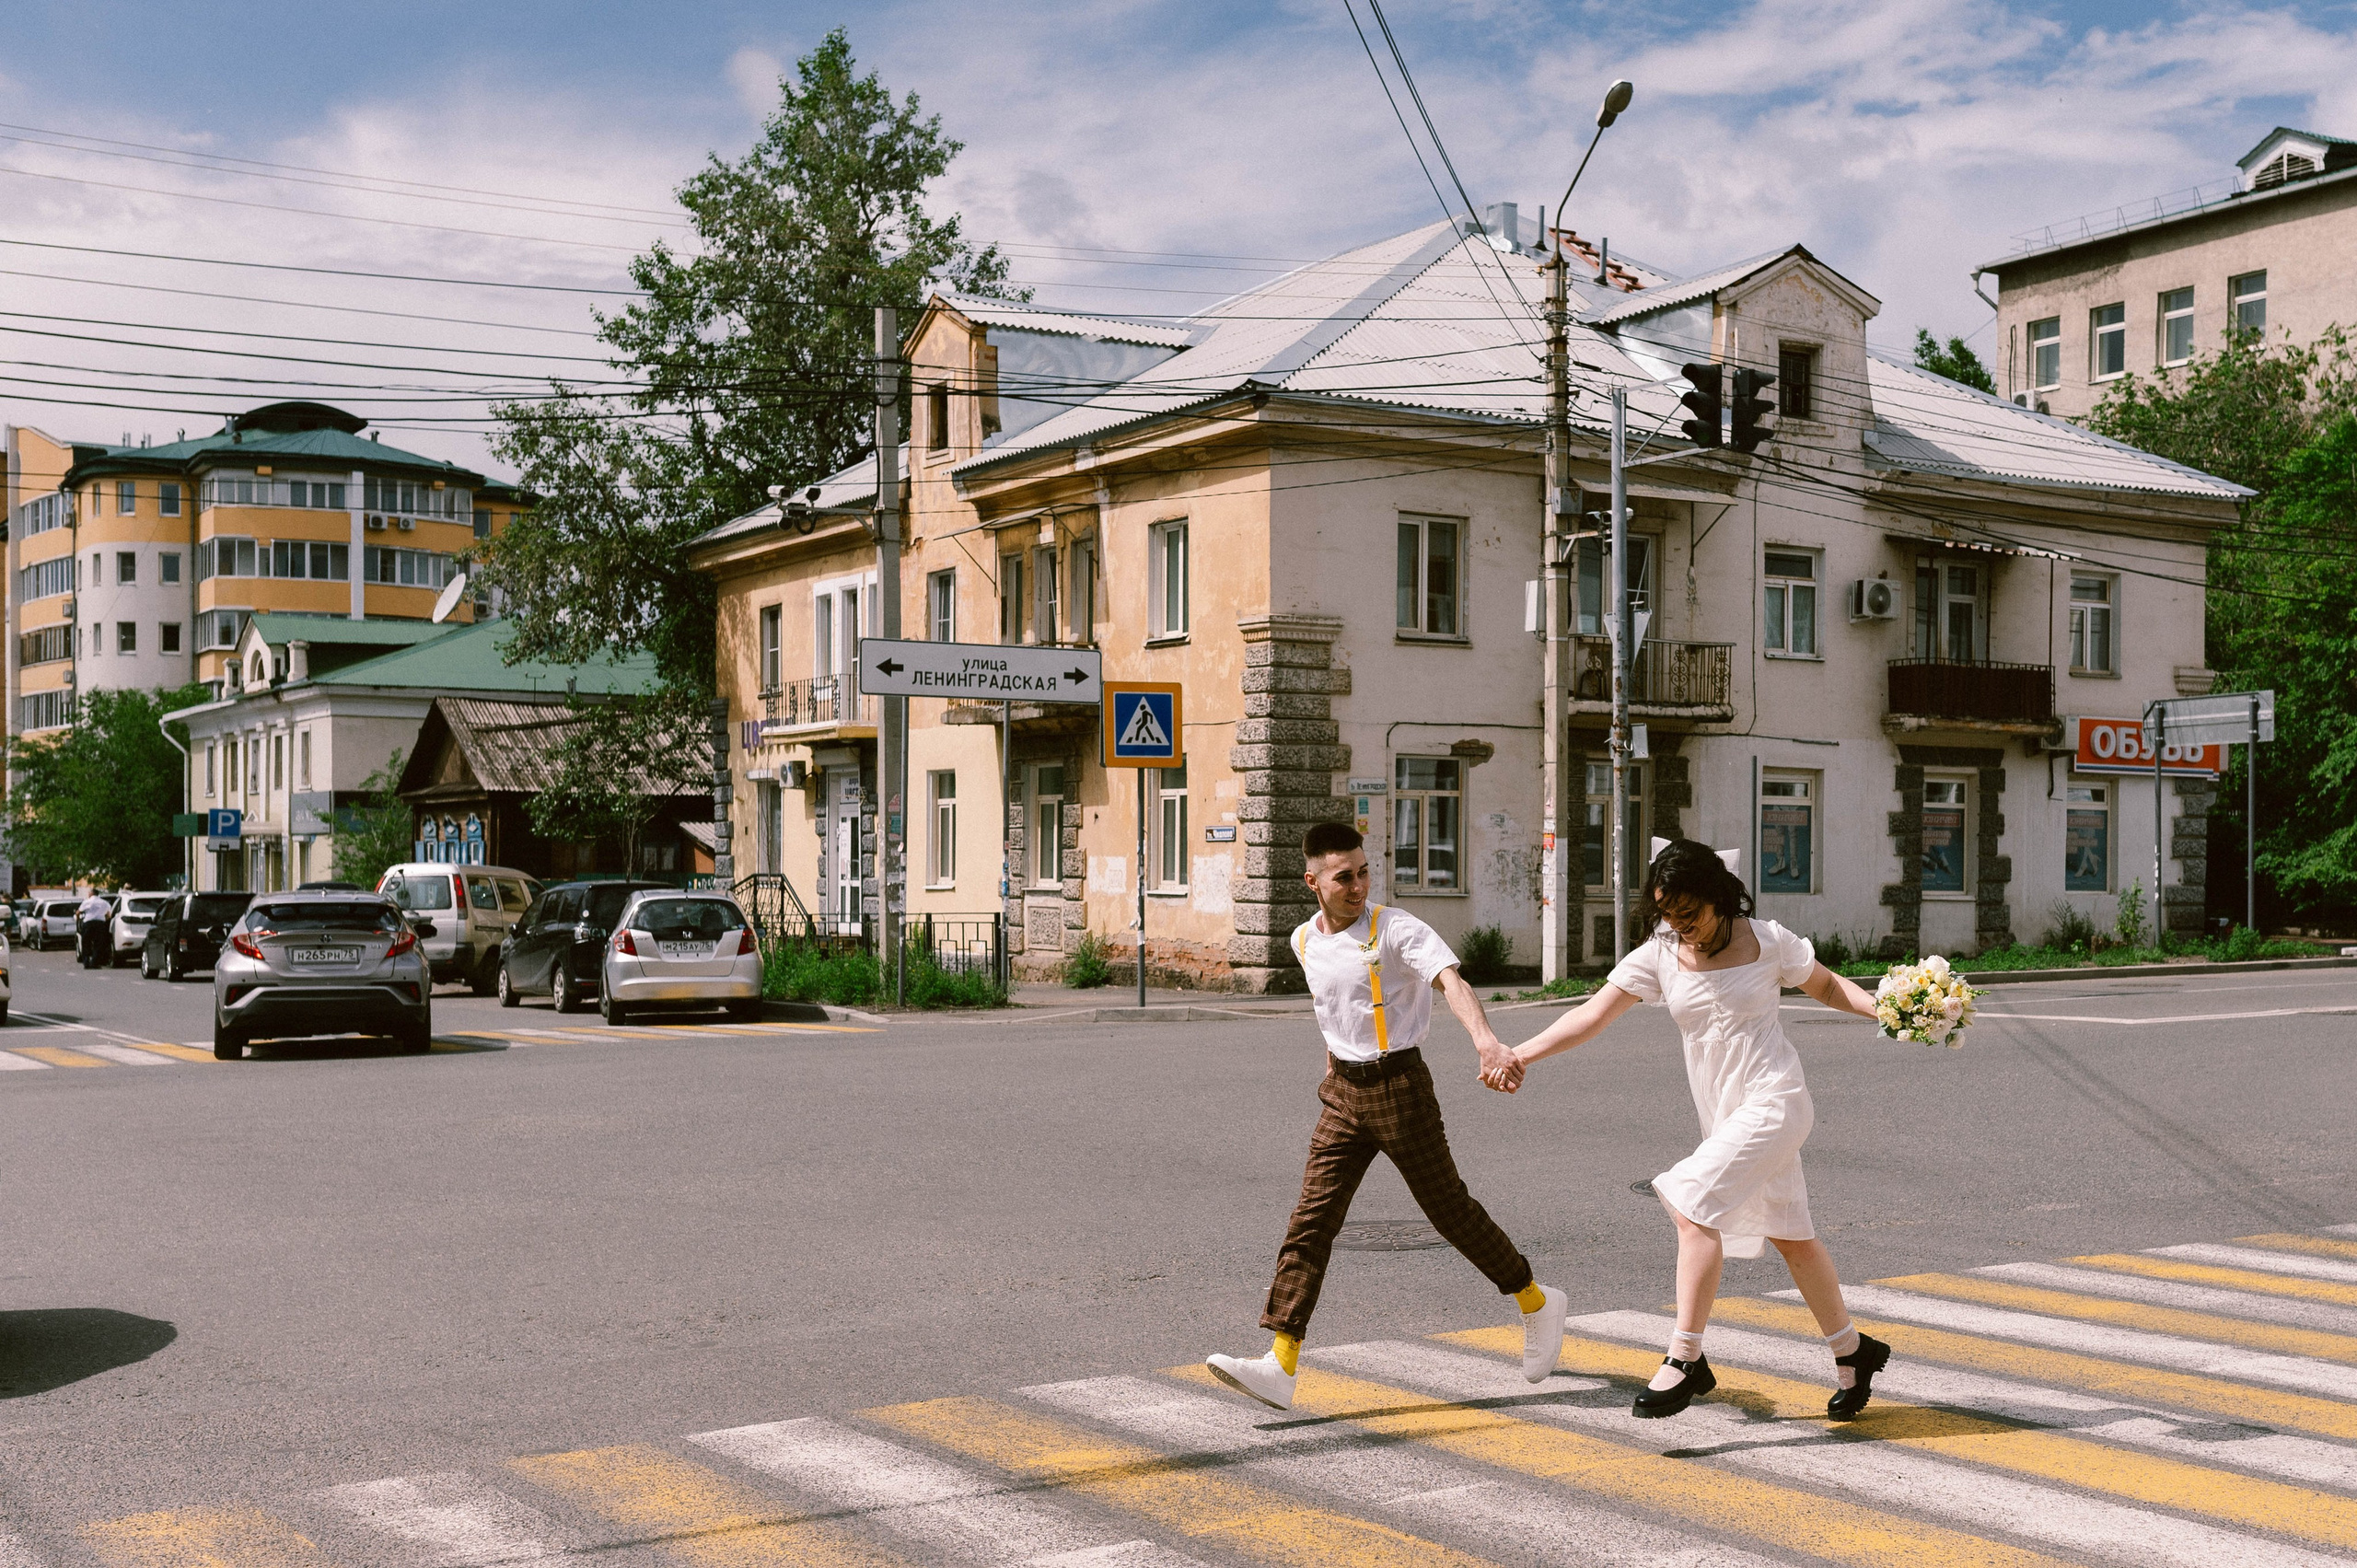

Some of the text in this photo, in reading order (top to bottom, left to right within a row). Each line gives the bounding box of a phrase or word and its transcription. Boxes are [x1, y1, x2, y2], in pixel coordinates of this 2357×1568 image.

[962, 658, 1007, 672] улица
[911, 670, 1057, 691] ЛЕНИНГРАДСКАЯ
[217, 811, 236, 834] P
[666, 940, 699, 951] М215АУ
[297, 949, 354, 960] Н265РН 75
